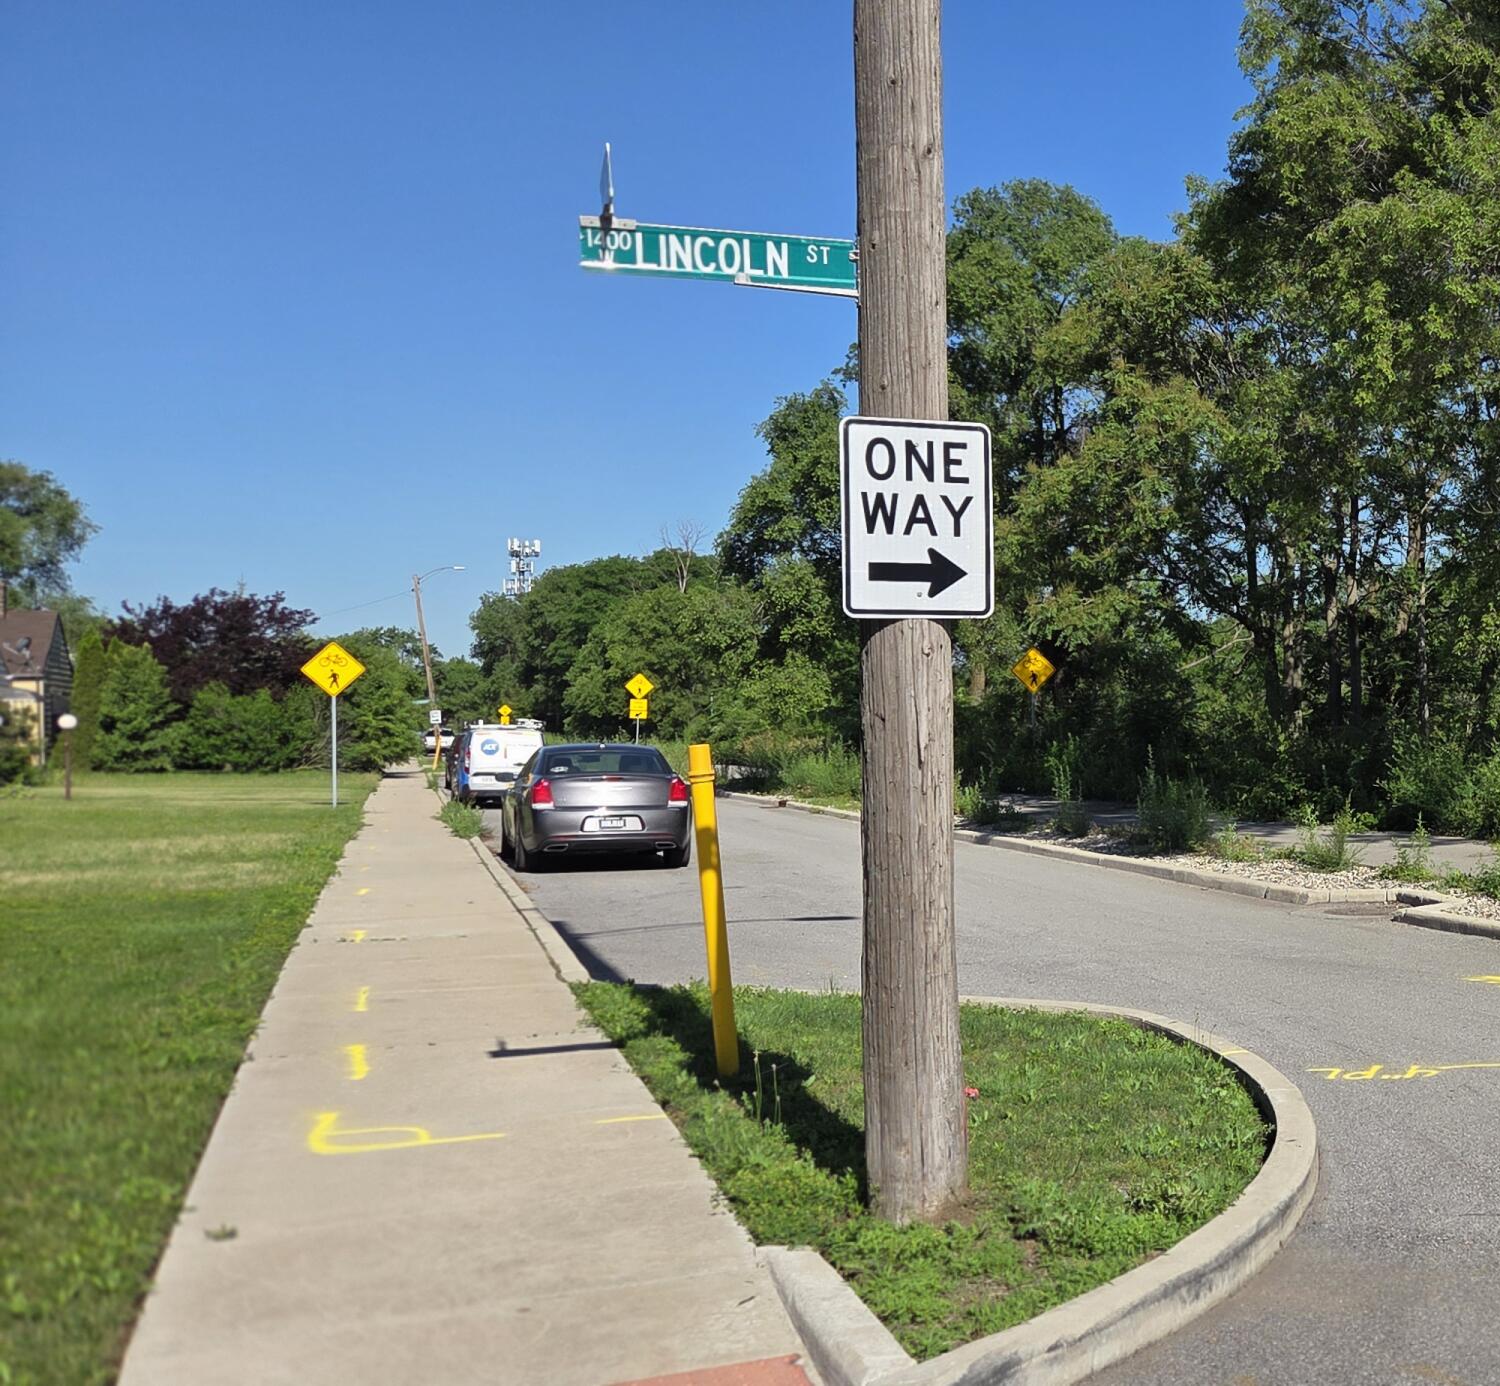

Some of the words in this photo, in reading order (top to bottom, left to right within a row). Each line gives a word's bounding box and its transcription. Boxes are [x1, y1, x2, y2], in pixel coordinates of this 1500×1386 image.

[635, 232, 789, 278] LINCOLN
[806, 244, 831, 265] ST
[865, 437, 970, 484] ONE
[861, 491, 974, 538] WAY
